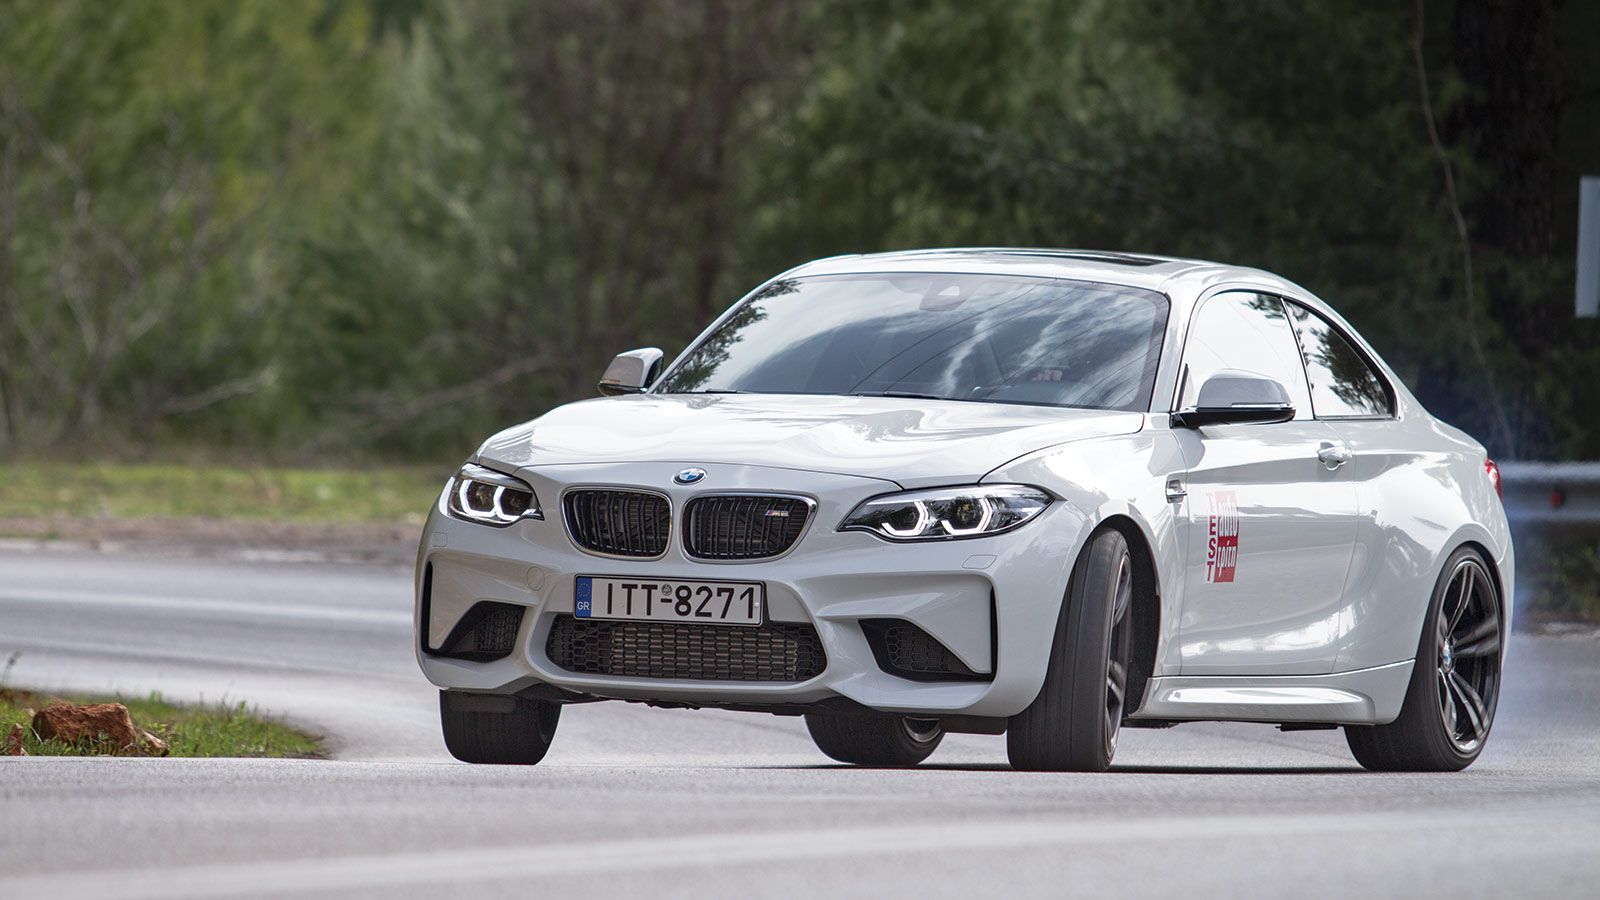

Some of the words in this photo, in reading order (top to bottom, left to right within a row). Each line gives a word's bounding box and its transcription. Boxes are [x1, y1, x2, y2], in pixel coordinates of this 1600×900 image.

[1206, 492, 1217, 582] TEST
[577, 601, 590, 611] GR
[607, 582, 755, 619] ITT-8271
